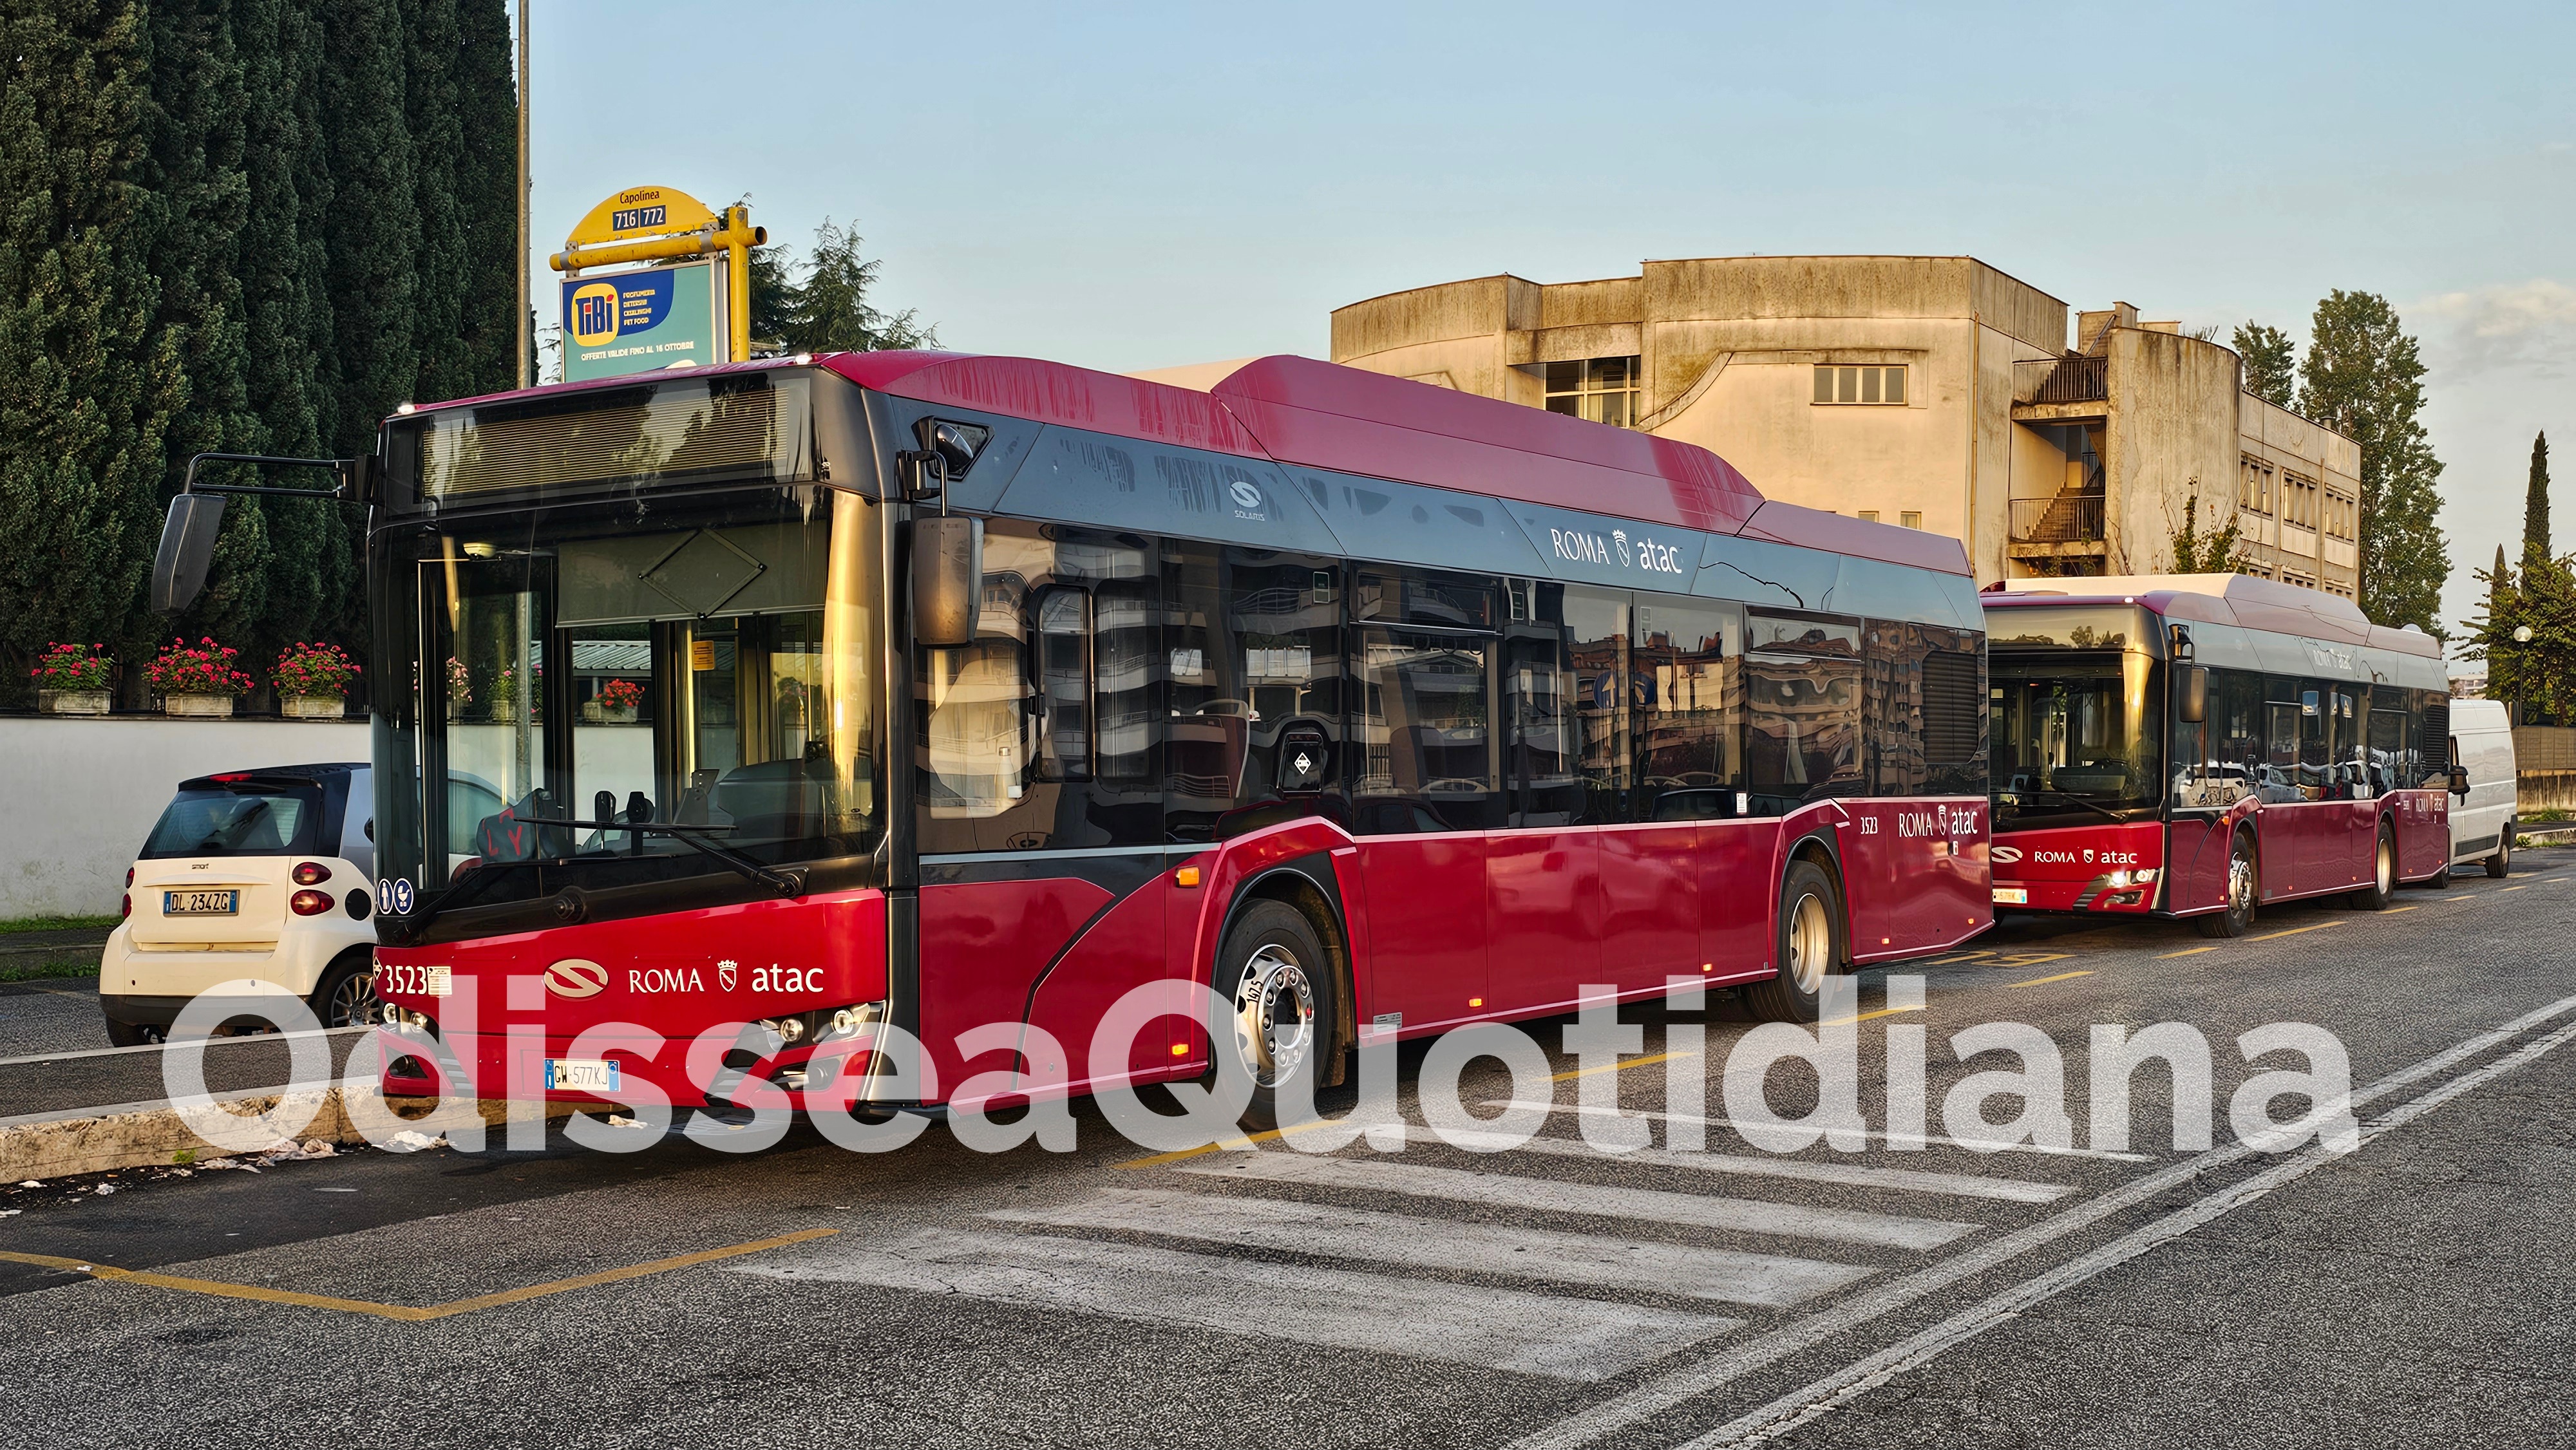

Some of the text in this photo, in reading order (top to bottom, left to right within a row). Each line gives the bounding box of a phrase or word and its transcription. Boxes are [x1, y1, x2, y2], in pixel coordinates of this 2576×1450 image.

[620, 190, 659, 205] Capolinea
[616, 208, 663, 228] 716 772
[581, 351, 607, 361] OFFERTE
[607, 348, 629, 357] VALIDE
[630, 347, 645, 355] FINO
[664, 341, 694, 351] OTTOBRE
[1235, 510, 1265, 521] SOLARIS
[1551, 528, 1682, 574] ROMA atac
[1861, 807, 1978, 837] 3523 ROMA atac
[2034, 851, 2137, 863] ROMA atac
[385, 965, 427, 995] 3523
[629, 963, 824, 993] ROMA atac
